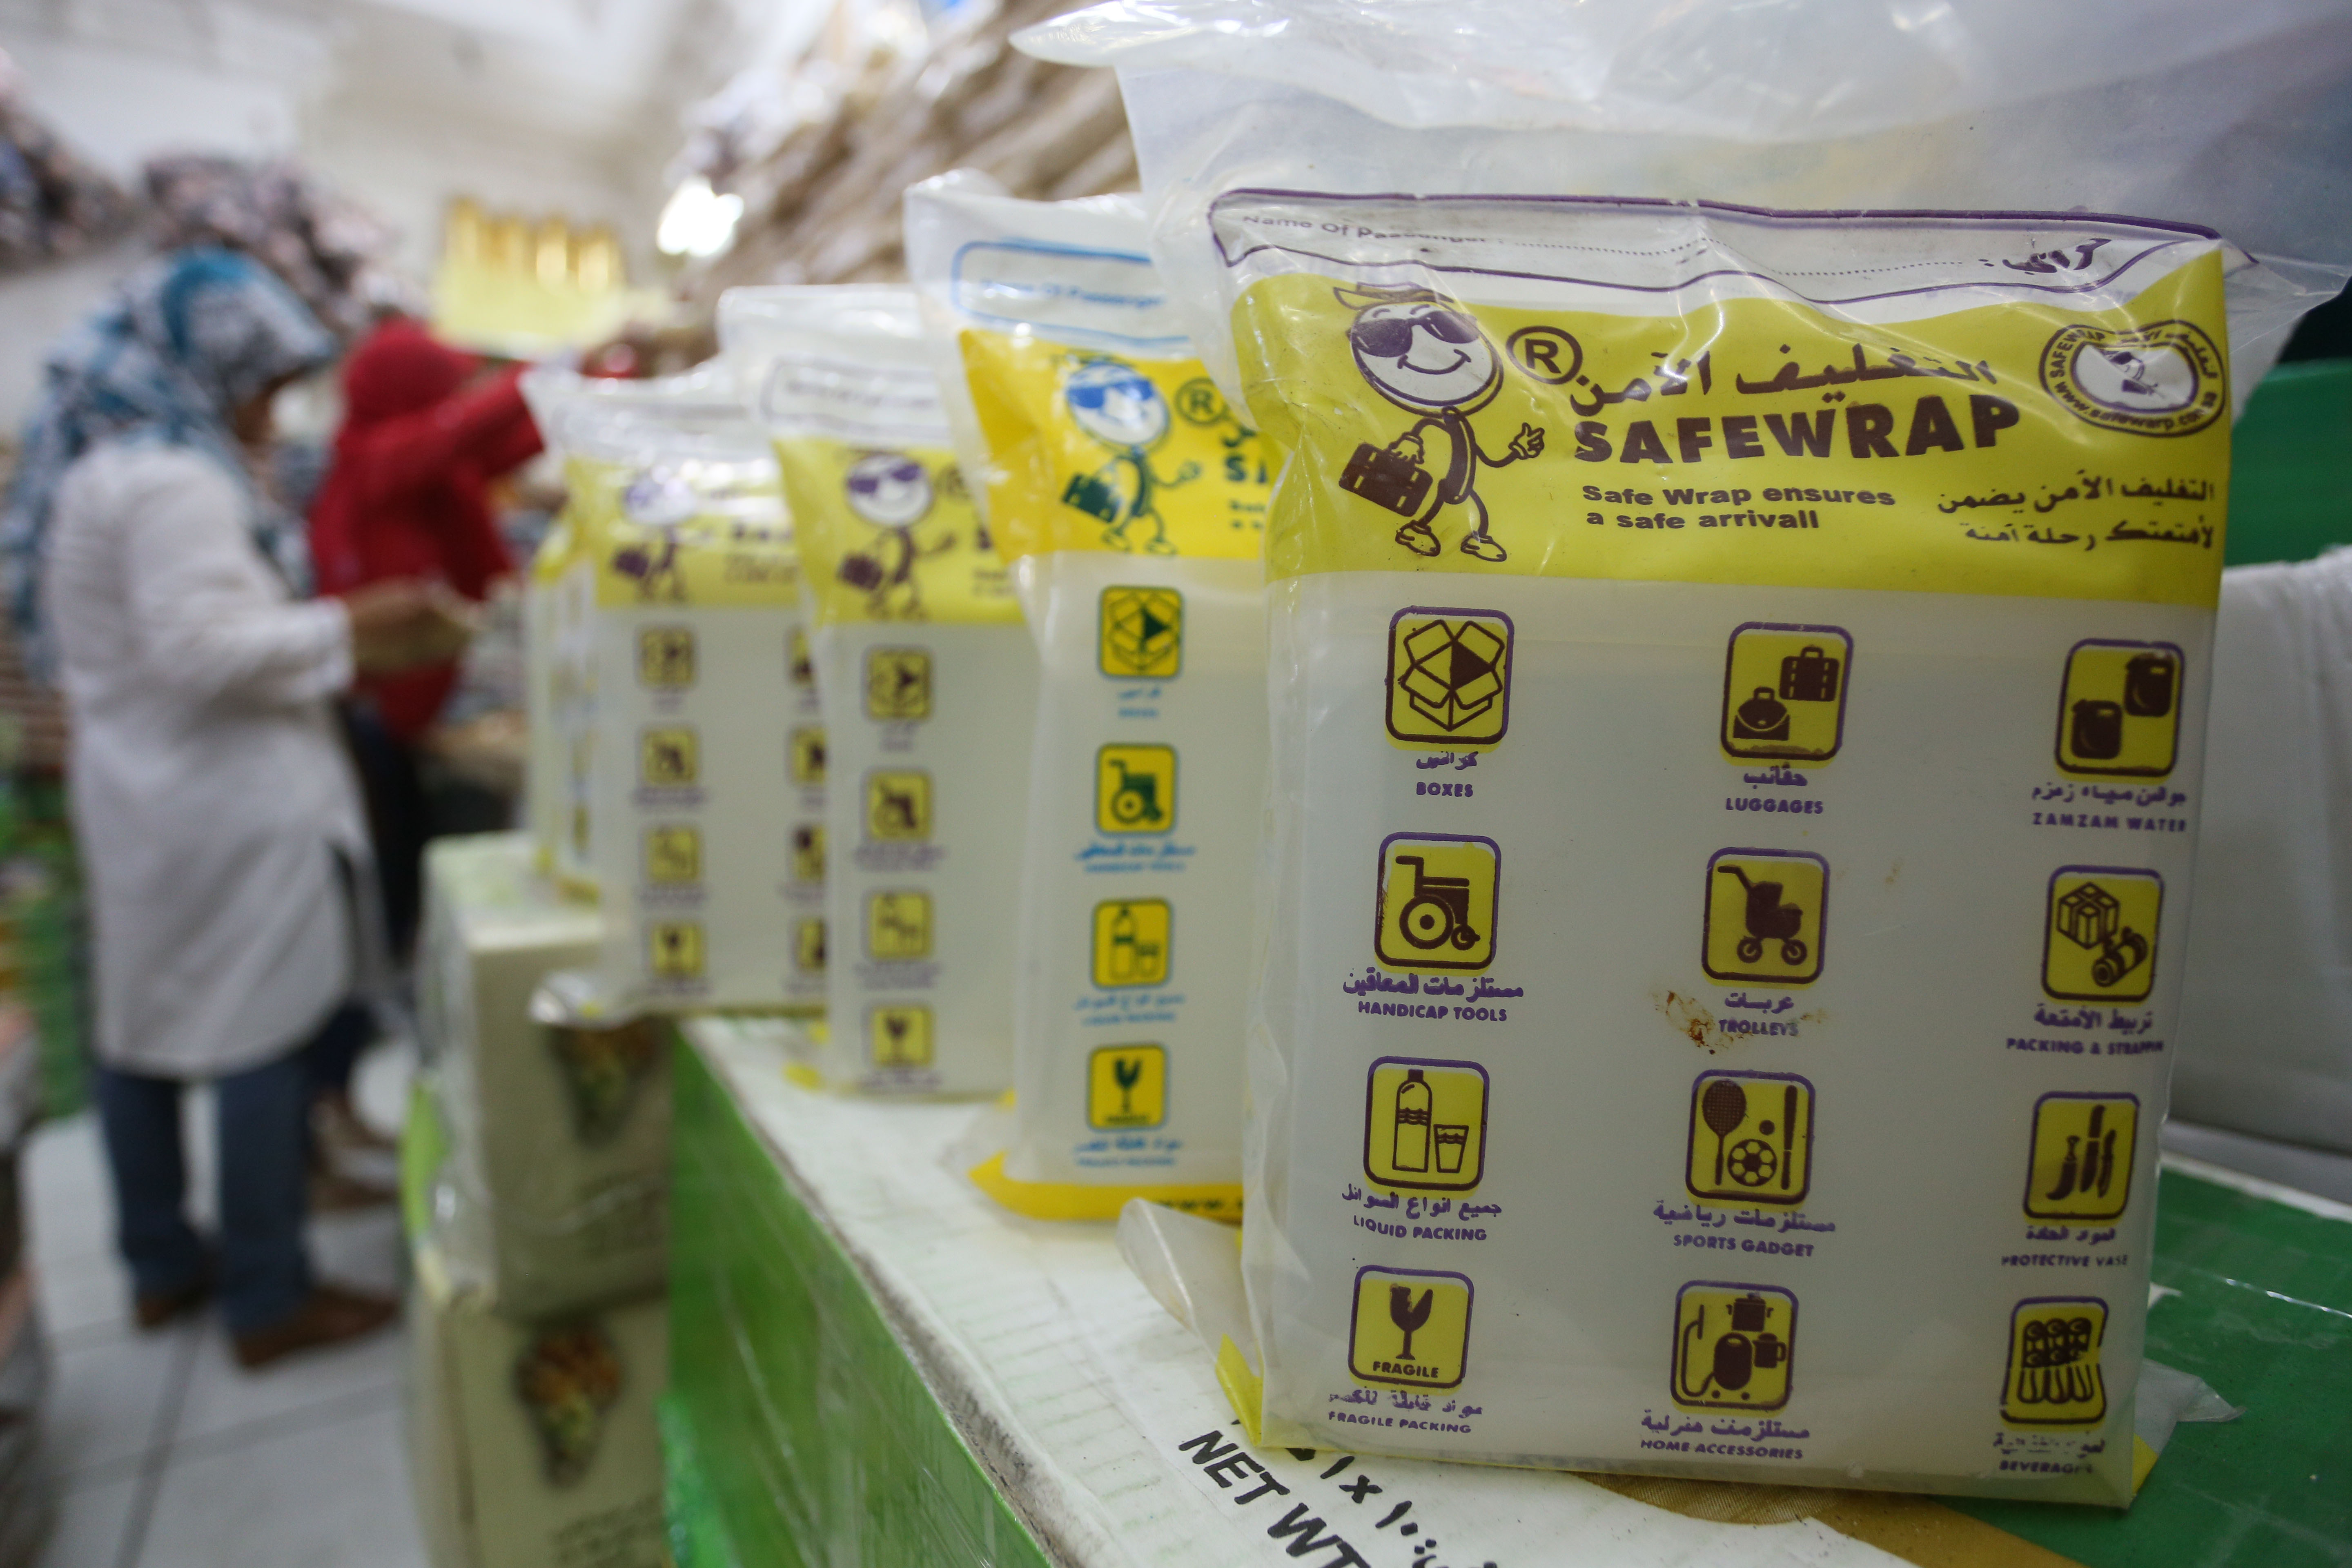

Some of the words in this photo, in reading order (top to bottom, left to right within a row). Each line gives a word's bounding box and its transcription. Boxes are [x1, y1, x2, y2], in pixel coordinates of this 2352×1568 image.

[1321, 221, 1348, 236] Of
[1573, 394, 2020, 464] SAFEWRAP
[1582, 485, 1653, 507] Safe
[1662, 488, 1752, 509] Wrap
[1762, 486, 1896, 507] ensures
[1586, 511, 1604, 526] a
[1616, 512, 1686, 530] safe
[1698, 510, 1820, 530] arrivall
[1416, 781, 1474, 797] BOXES
[1726, 797, 1824, 814] LUGGAGES
[2032, 812, 2119, 829] ZAMZAM
[1358, 1000, 1449, 1019] HANDICAP
[1453, 1007, 1508, 1022] TOOLS
[1719, 1019, 1800, 1037] TROLLEYS
[2006, 1037, 2085, 1055] PACKING
[1353, 1215, 1407, 1238] LIQUID
[1412, 1226, 1487, 1241] PACKING
[1673, 1234, 1737, 1251] SPORTS
[1741, 1238, 1815, 1257] GADGET
[2000, 1254, 2090, 1267] PROTECTIVE
[1372, 1361, 1439, 1379] FRAGILE
[1328, 1411, 1394, 1428] FRAGILE
[1399, 1418, 1472, 1434] PACKING
[1640, 1439, 1690, 1452] HOME
[1694, 1443, 1803, 1459] ACCESSORIES
[1178, 1430, 1291, 1505] NET
